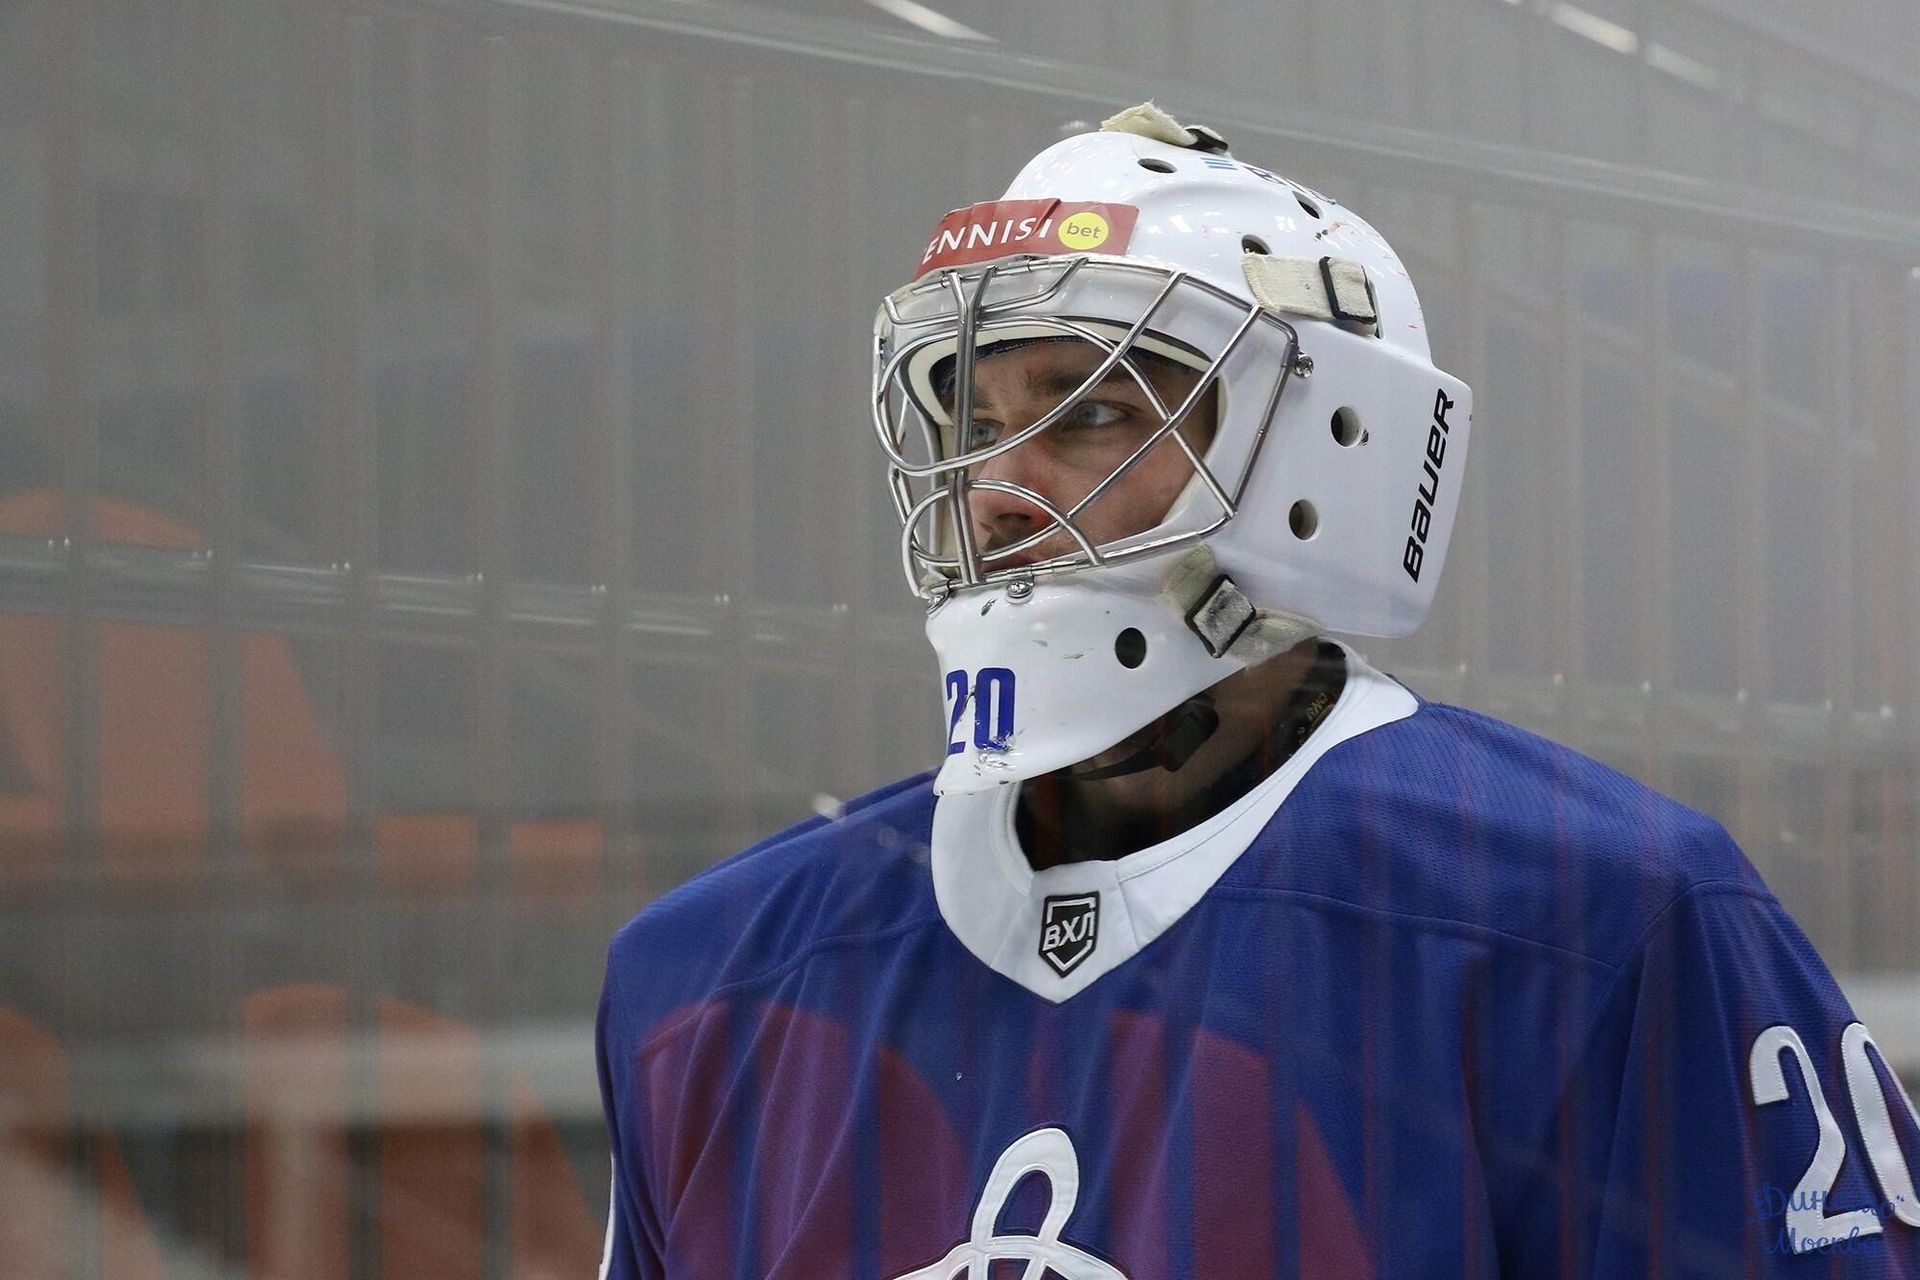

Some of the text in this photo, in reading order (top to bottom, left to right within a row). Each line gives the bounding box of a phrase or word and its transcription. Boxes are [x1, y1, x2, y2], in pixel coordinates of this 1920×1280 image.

[1066, 222, 1102, 239] bet
[946, 667, 1016, 756] 20
[1749, 1022, 1920, 1255] 20
